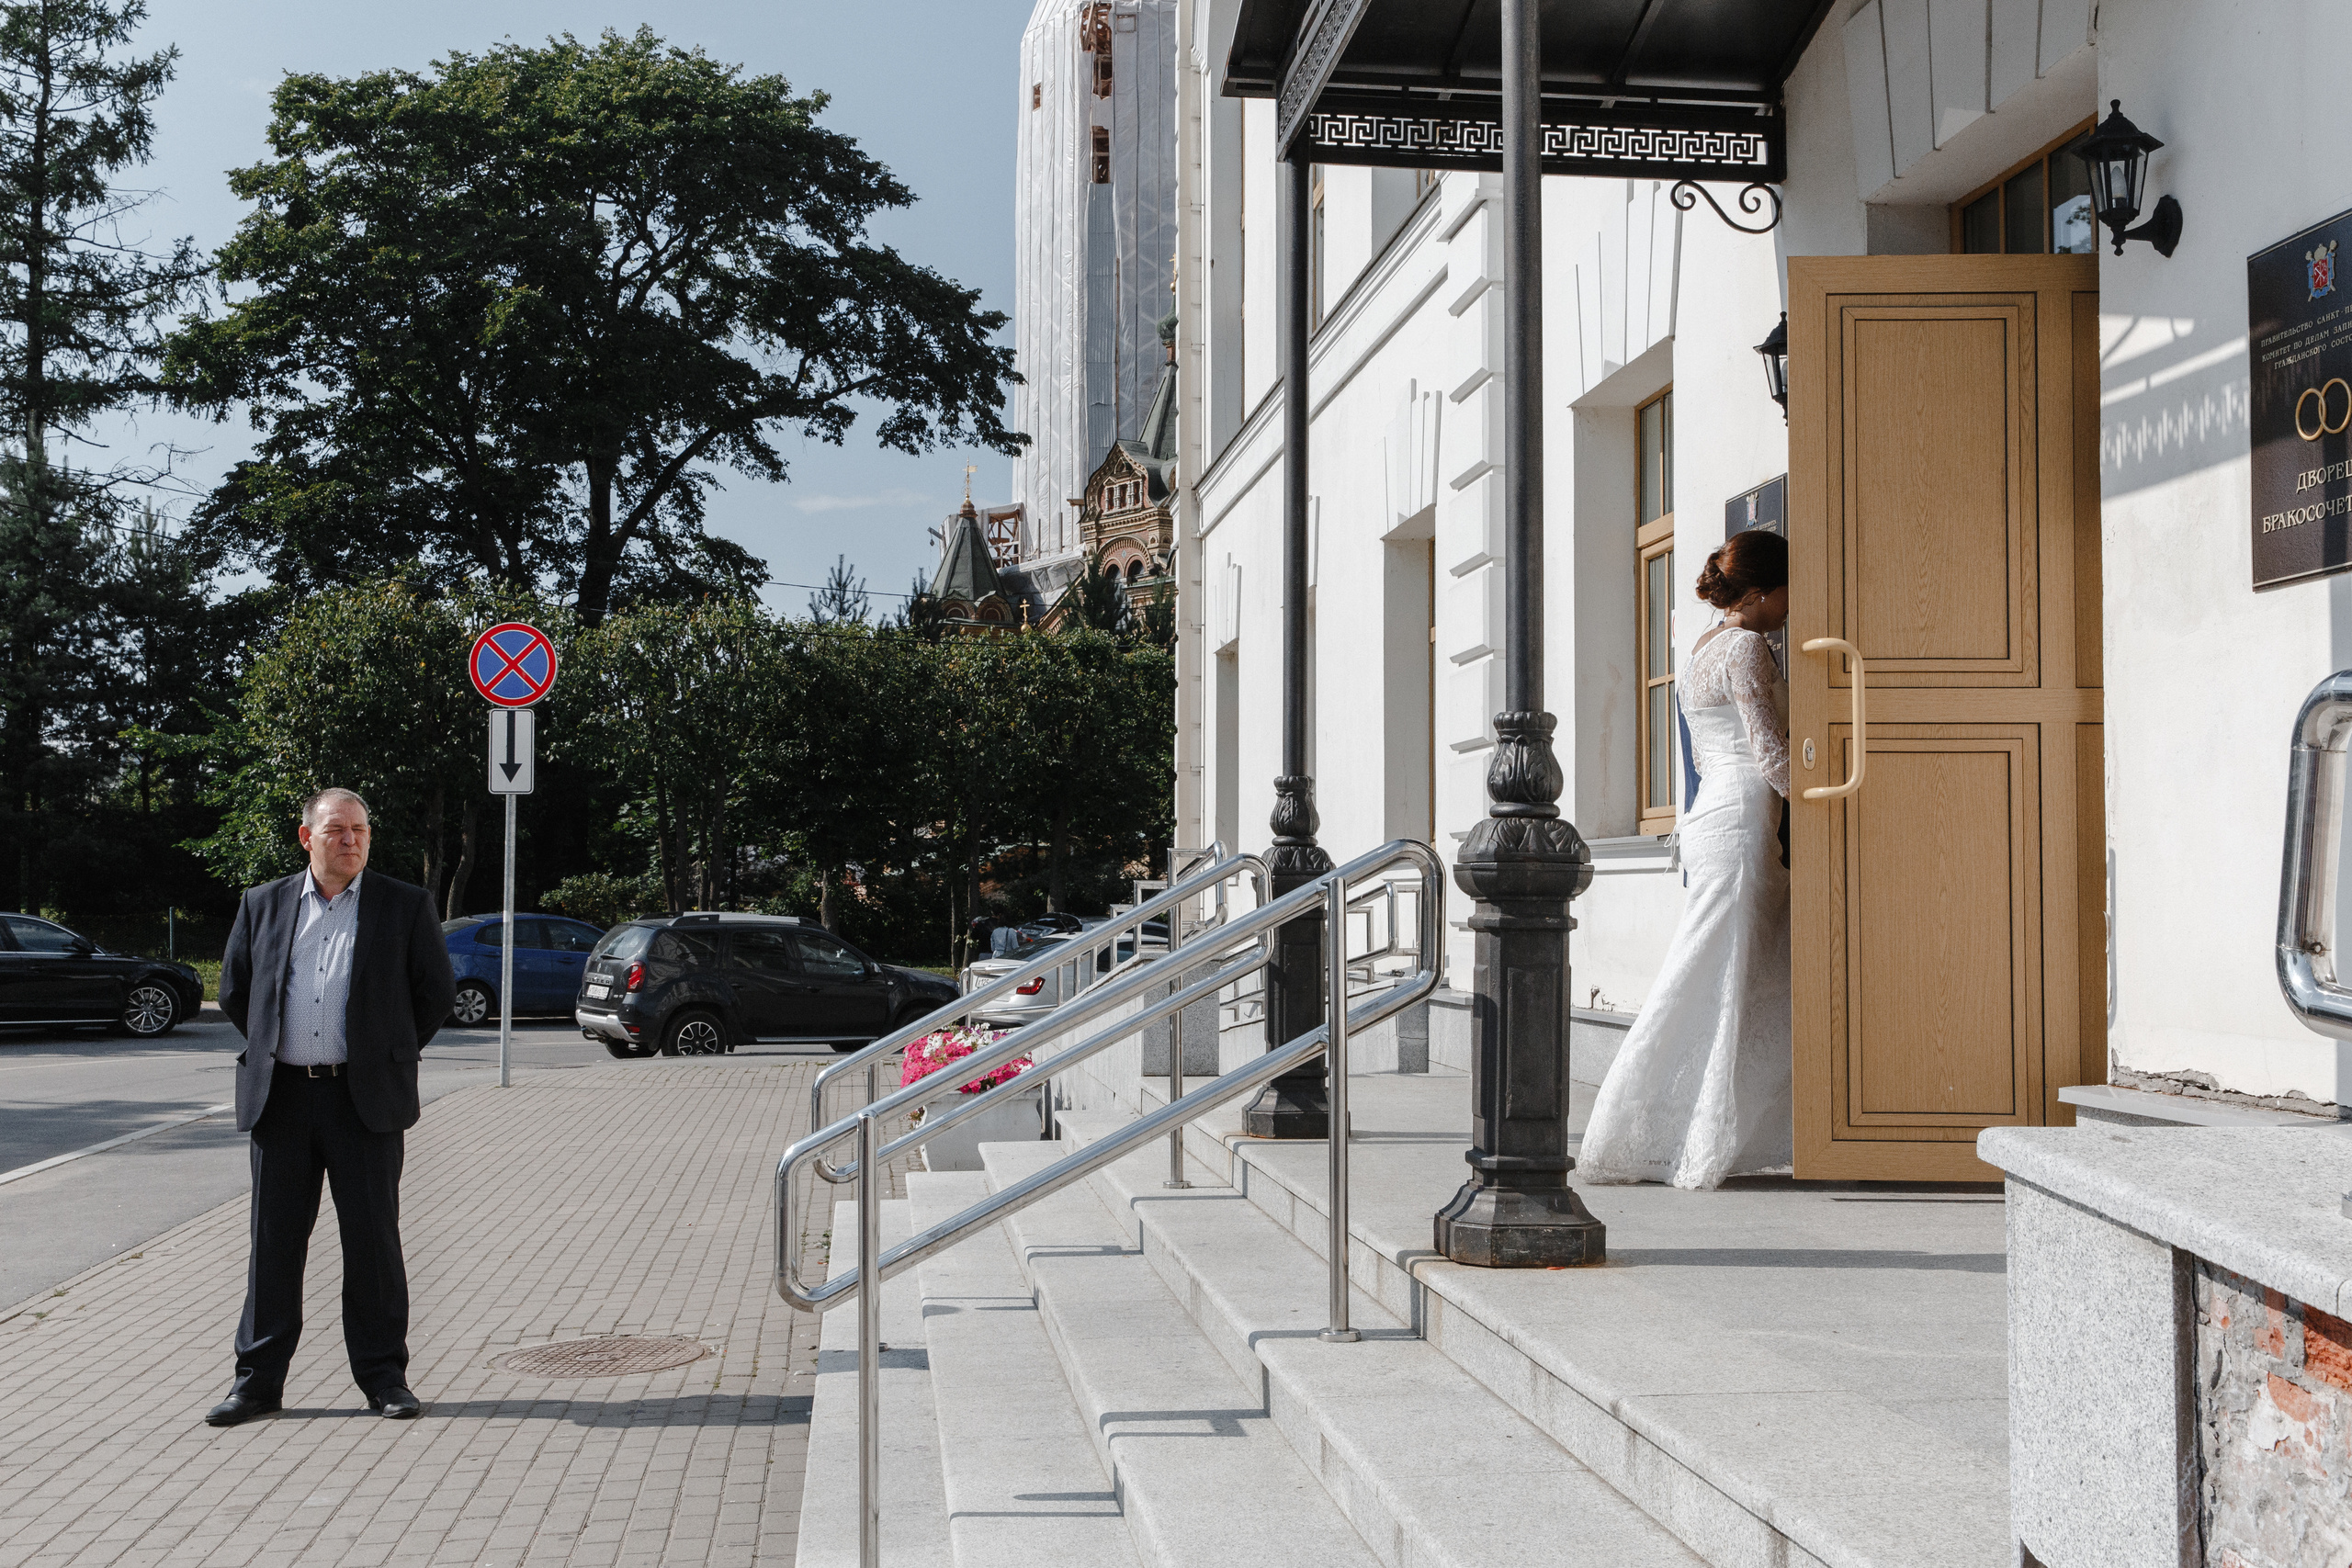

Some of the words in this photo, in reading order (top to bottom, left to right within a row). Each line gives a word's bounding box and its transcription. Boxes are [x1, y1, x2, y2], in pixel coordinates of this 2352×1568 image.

[2260, 321, 2313, 348] ПРАВИТЕЛЬСТВО
[2262, 344, 2291, 363] КОМИТЕТ
[2293, 340, 2302, 350] ПО
[2304, 329, 2330, 346] ДЕЛАМ
[2274, 344, 2327, 370] ГРАЖДАНСКОГО
[2262, 494, 2352, 534] БРАКОСОЧЕТ
